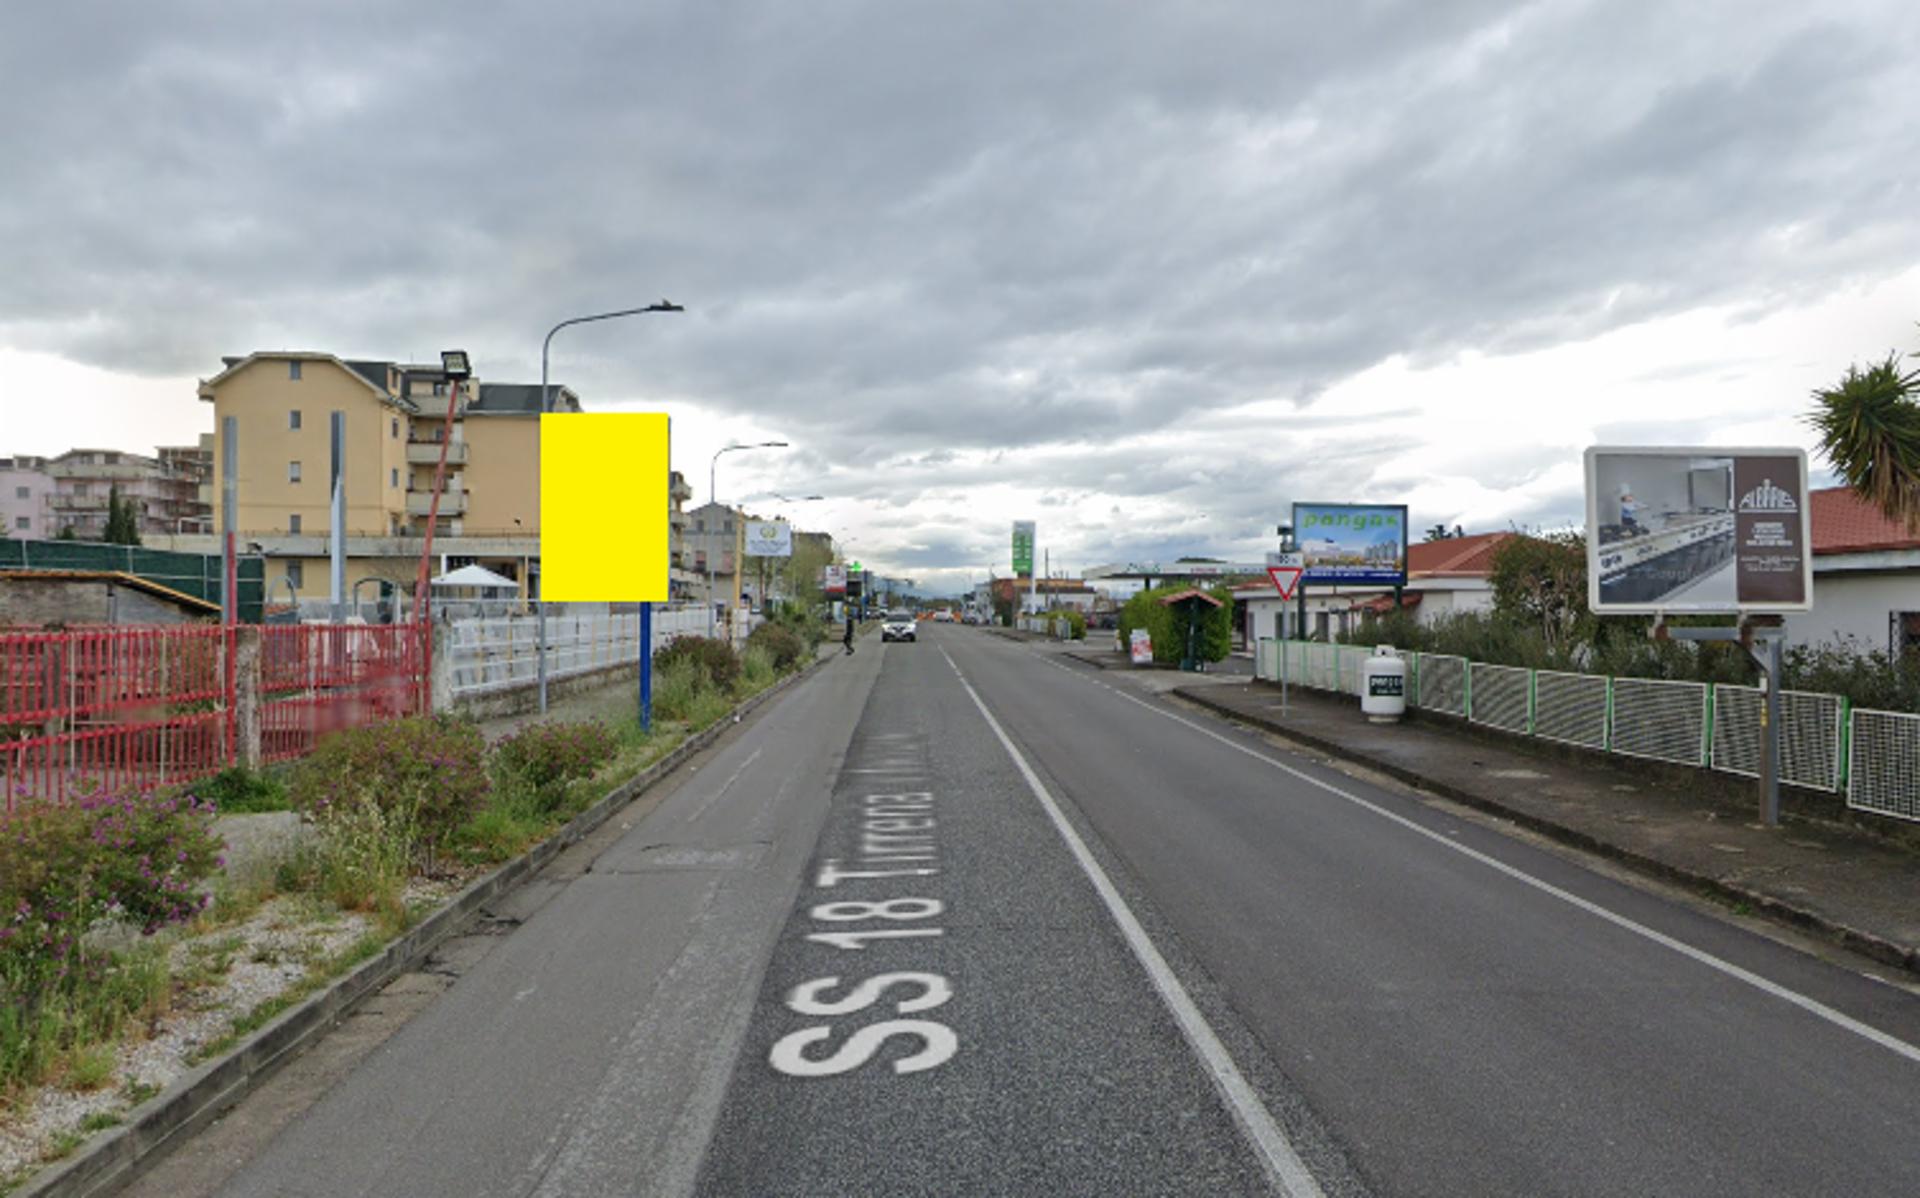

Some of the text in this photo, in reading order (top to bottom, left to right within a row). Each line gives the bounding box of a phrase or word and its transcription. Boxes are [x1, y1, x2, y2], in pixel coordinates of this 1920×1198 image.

[816, 791, 940, 887] Tirrena
[804, 897, 946, 949] 18
[769, 971, 958, 1077] SS
